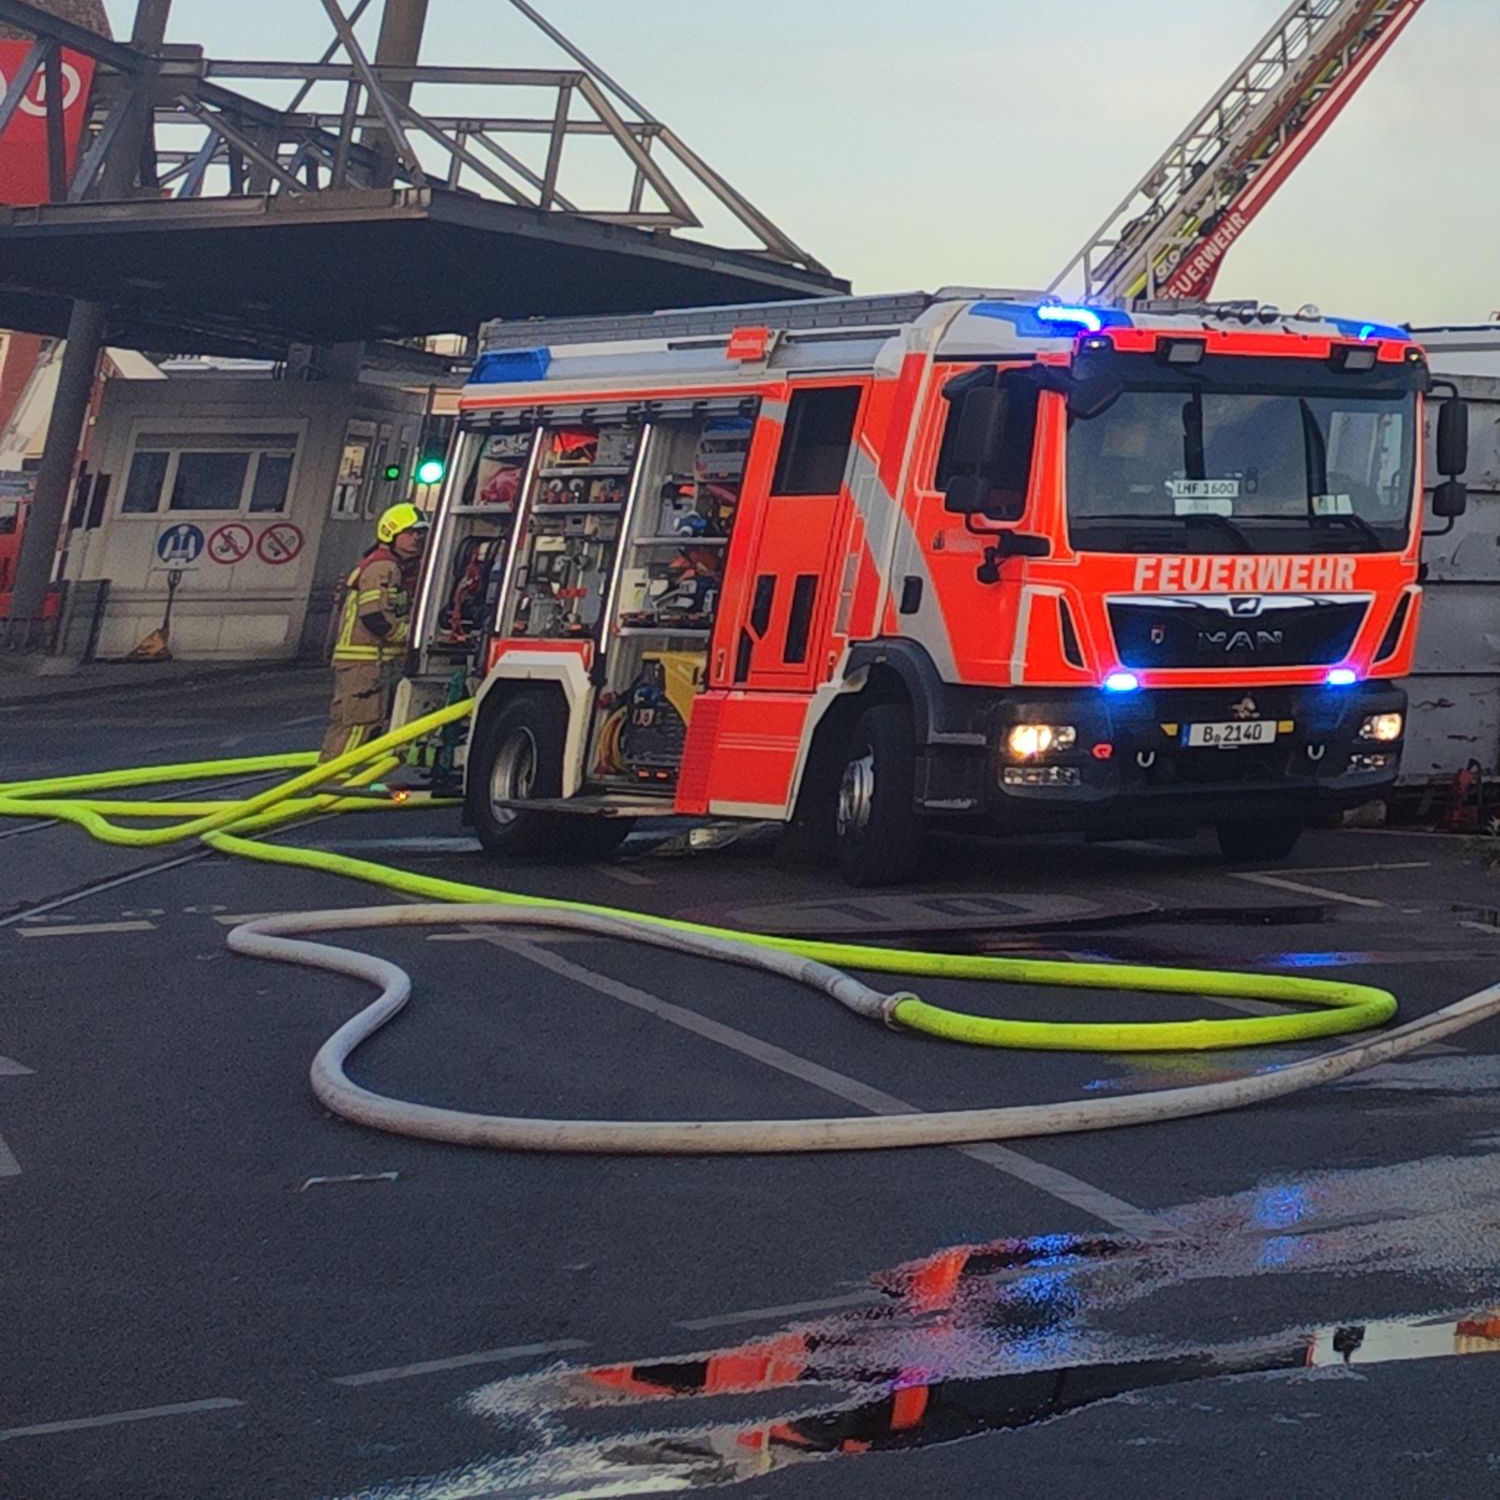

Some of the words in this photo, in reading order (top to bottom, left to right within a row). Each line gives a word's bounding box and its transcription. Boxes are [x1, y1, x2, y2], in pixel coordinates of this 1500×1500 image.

[1162, 212, 1246, 300] EUERWEHR
[1203, 482, 1235, 495] 1600
[1134, 557, 1356, 591] FEUERWEHR
[1198, 630, 1283, 651] MAN
[1203, 725, 1214, 743] B
[1223, 723, 1263, 742] 2140
